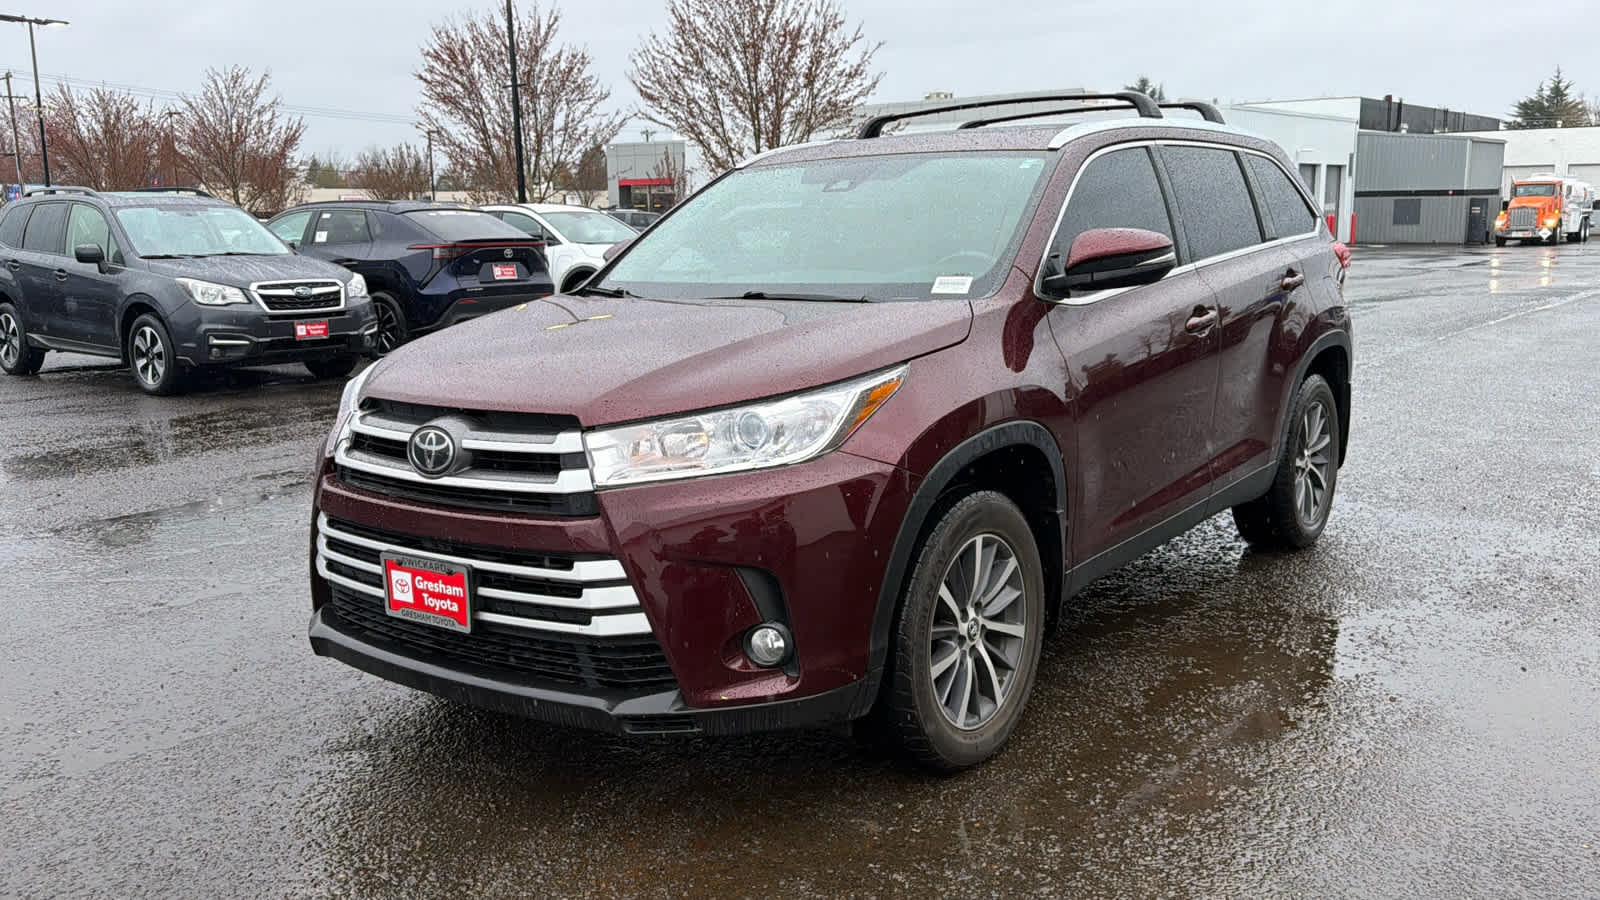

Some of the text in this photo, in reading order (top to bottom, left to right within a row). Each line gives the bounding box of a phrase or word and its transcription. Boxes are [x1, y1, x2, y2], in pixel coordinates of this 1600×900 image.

[415, 575, 464, 598] Gresham
[422, 592, 459, 612] Toyota
[401, 608, 457, 628] GRESHAM TOYOTA
